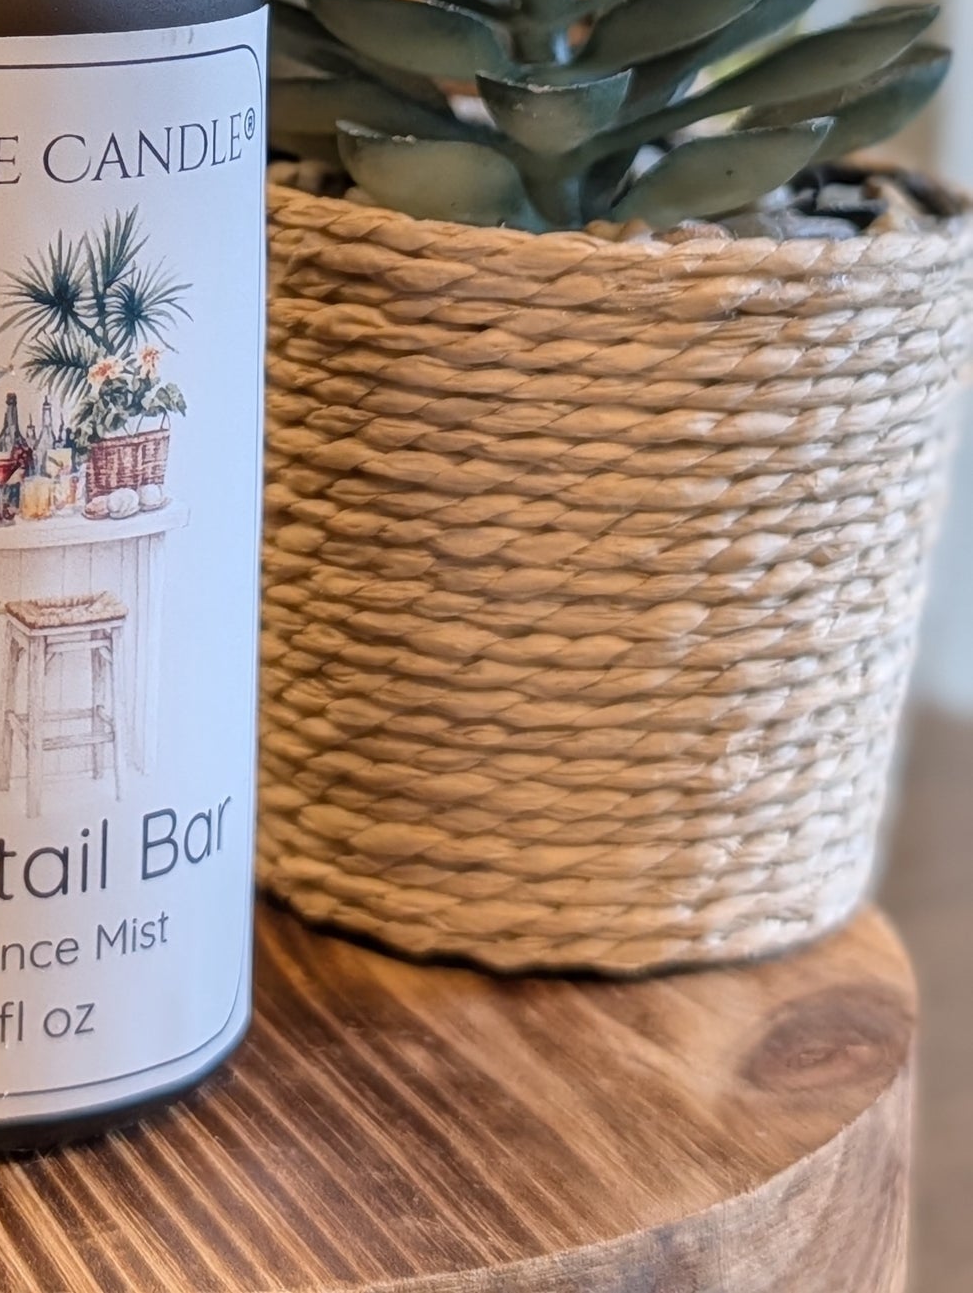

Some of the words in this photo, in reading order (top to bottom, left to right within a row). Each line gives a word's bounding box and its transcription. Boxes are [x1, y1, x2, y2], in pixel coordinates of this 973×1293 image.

[141, 796, 232, 881] Bar
[96, 910, 170, 961] Mist
[42, 1002, 96, 1038] oz
